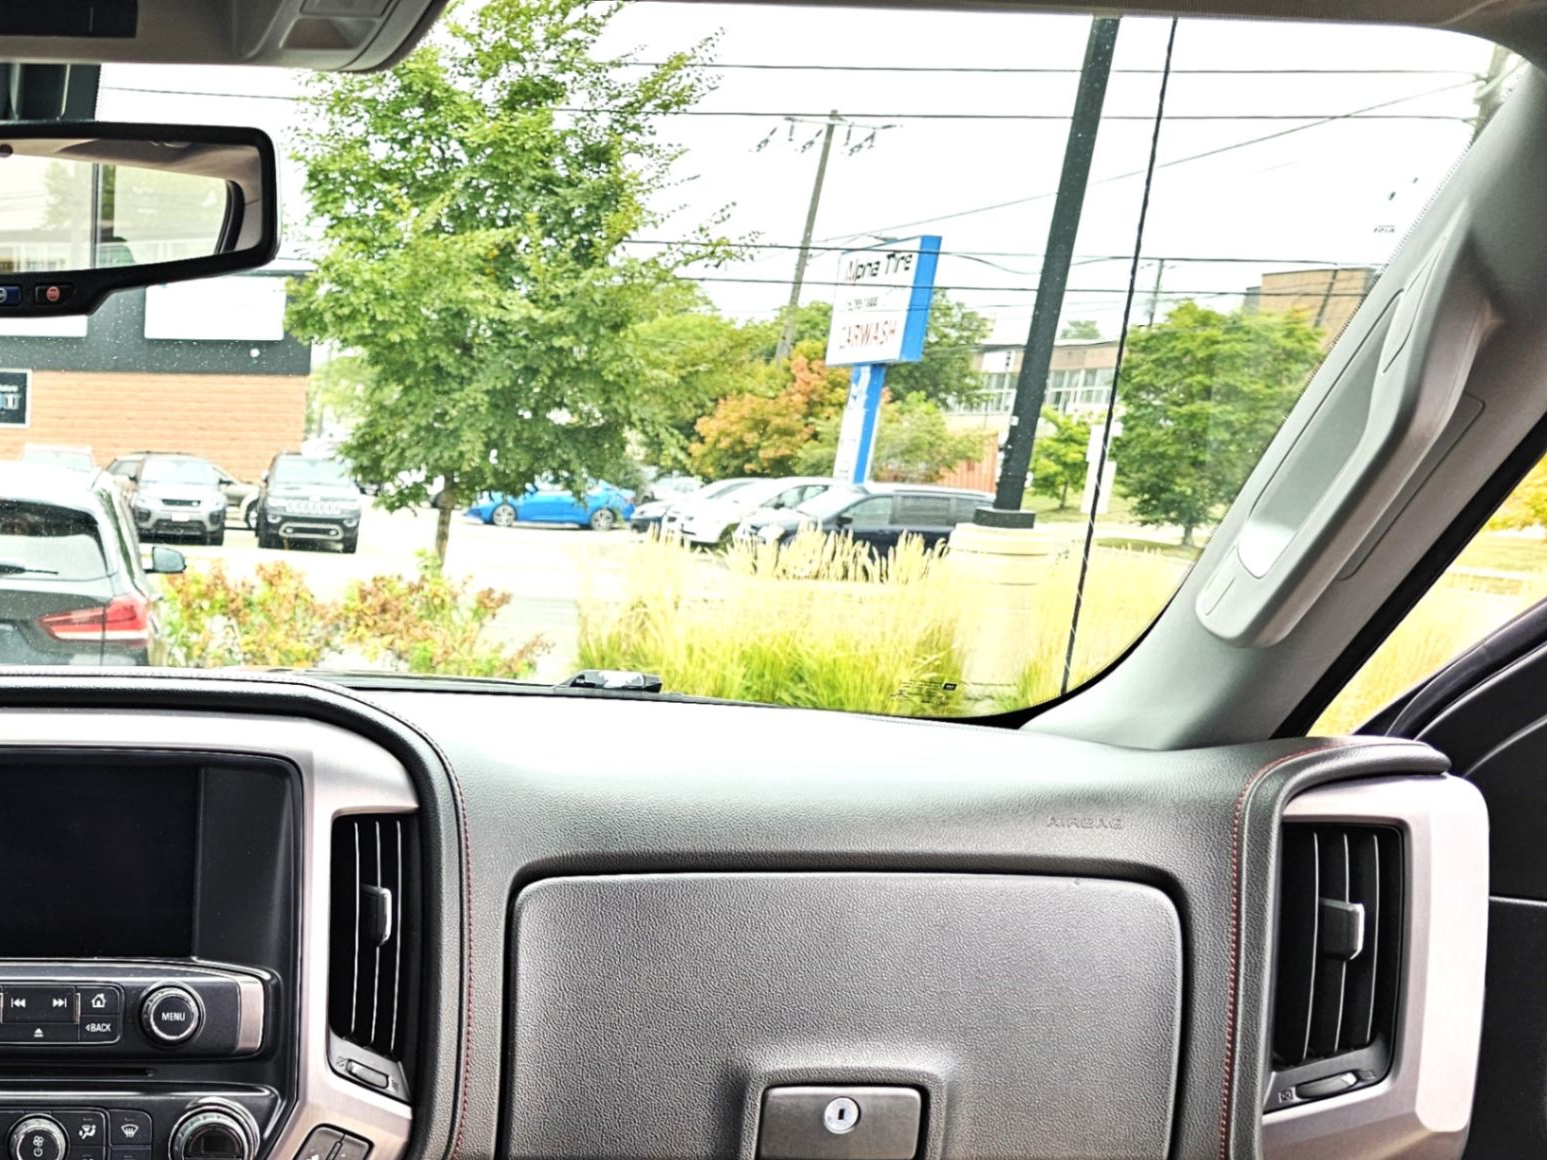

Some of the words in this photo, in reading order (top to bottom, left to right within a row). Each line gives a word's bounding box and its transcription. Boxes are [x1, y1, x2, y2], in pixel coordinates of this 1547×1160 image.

[884, 251, 913, 275] Tire
[1046, 815, 1123, 830] AIRBAG
[161, 1012, 186, 1022] MENU
[90, 1022, 111, 1033] BACK
